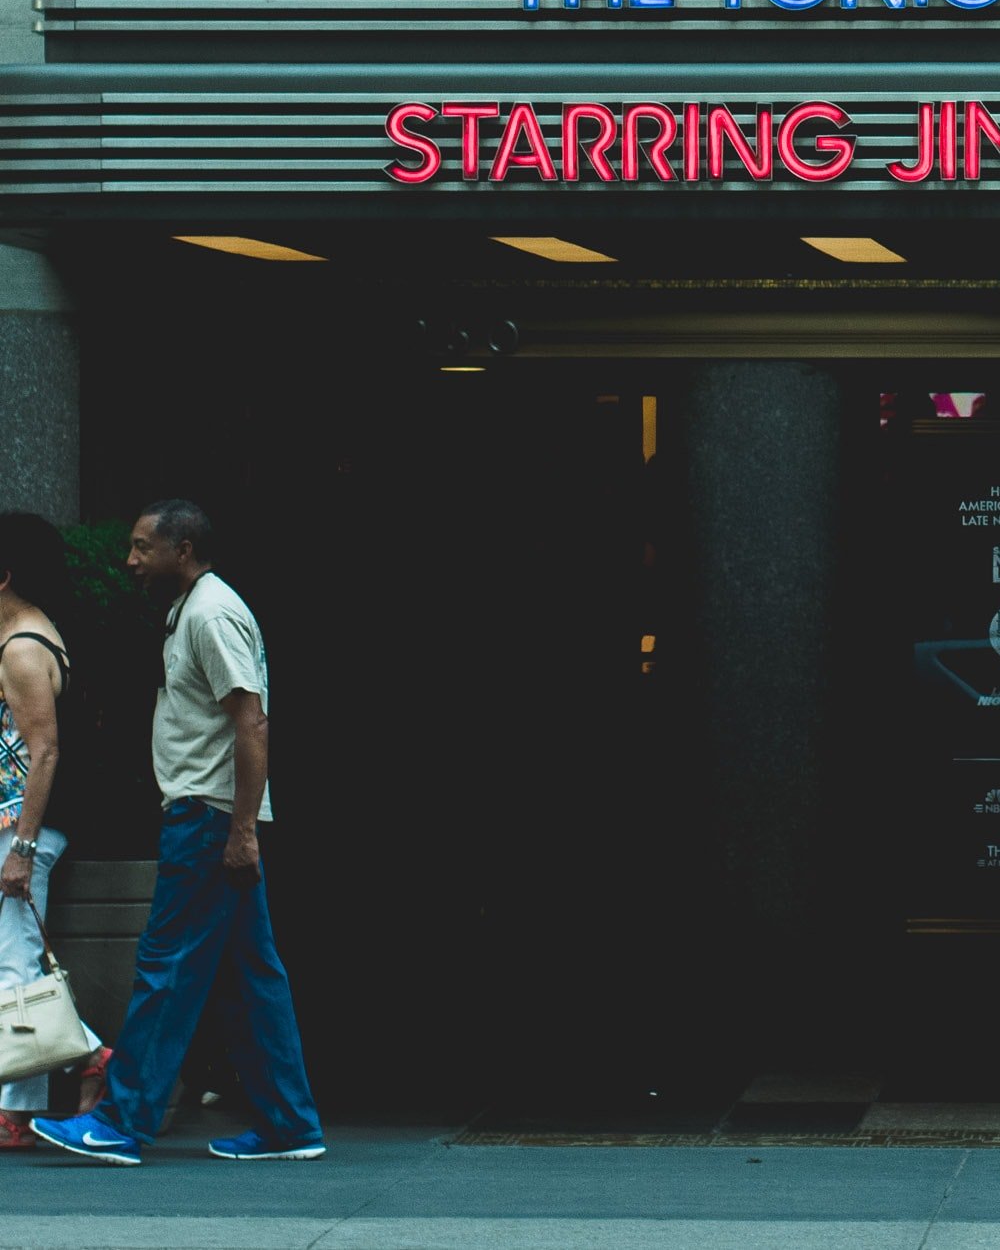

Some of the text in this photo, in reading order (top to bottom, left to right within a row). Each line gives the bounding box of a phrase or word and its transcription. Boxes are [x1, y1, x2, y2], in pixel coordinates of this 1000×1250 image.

[382, 100, 858, 184] STARRING
[962, 515, 989, 526] LATE
[987, 859, 997, 868] AT
